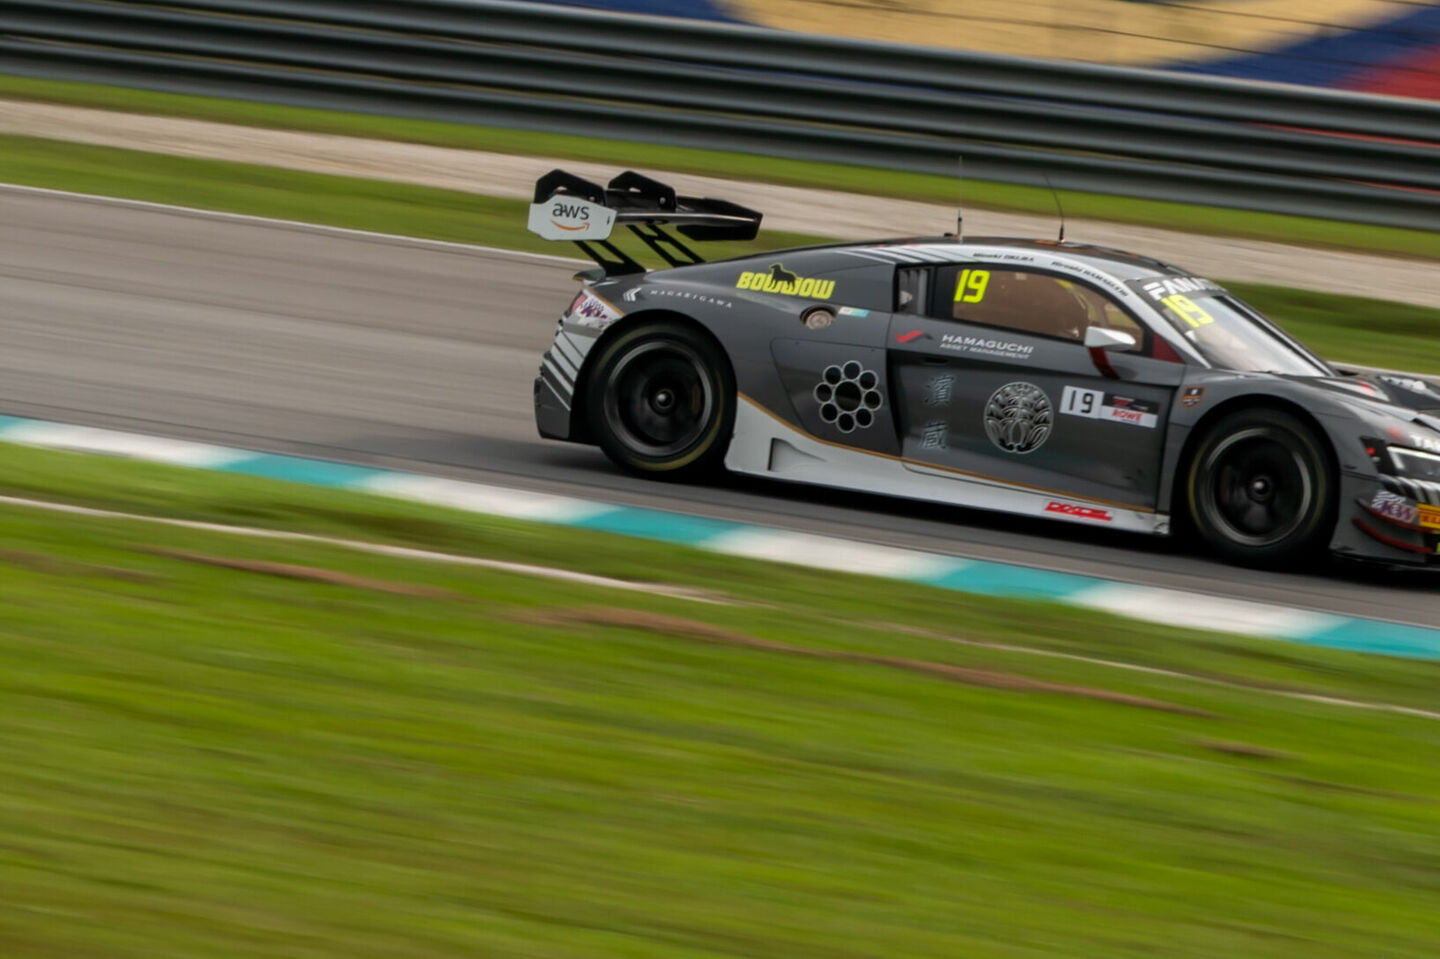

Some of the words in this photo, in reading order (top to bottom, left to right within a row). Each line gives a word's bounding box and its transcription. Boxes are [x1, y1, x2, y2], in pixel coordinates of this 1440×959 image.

[552, 203, 590, 221] aws
[953, 269, 990, 303] 19
[1160, 293, 1214, 328] 19
[939, 343, 969, 352] ASSET
[942, 333, 1034, 354] HAMAGUCHI
[1069, 390, 1095, 414] 19
